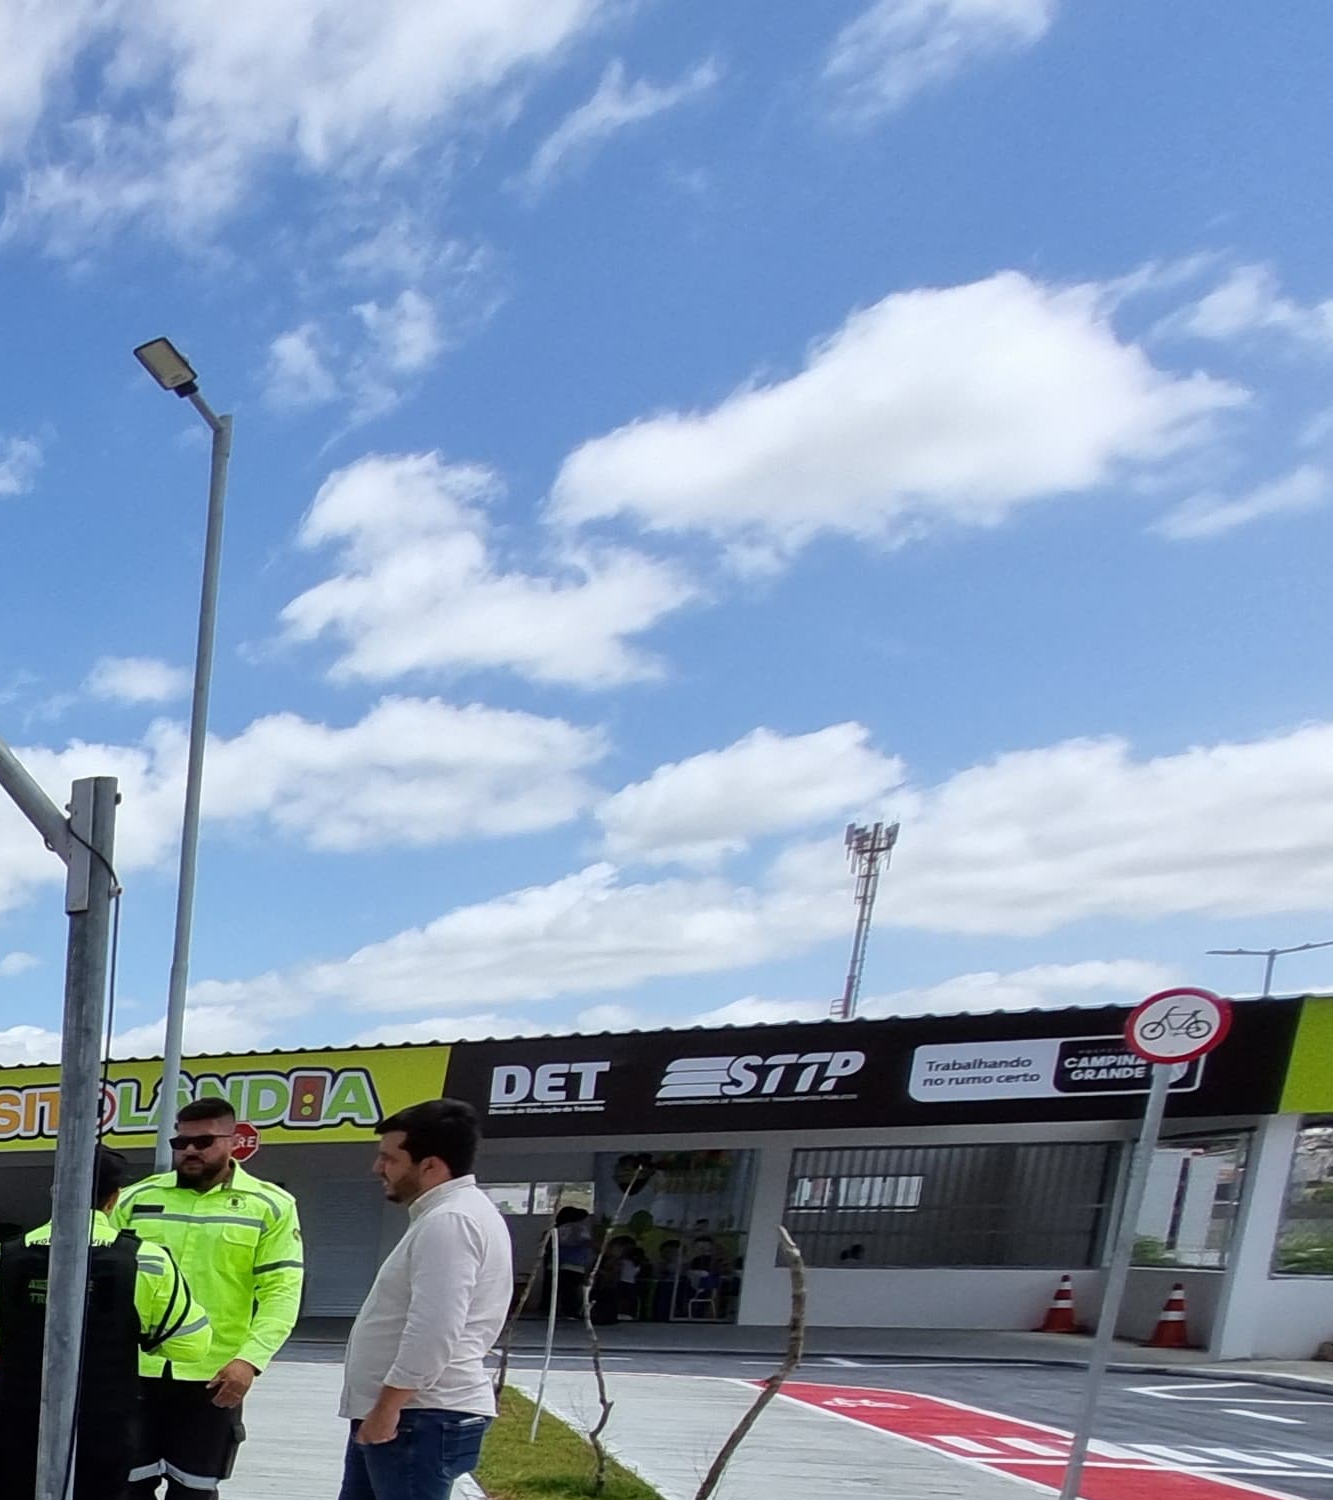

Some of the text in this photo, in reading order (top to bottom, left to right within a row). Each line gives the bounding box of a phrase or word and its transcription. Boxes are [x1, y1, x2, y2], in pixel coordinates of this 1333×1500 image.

[926, 1056, 1033, 1072] Trabalhando
[1063, 1054, 1147, 1069] CAMPINA
[721, 1050, 866, 1096] STTP
[922, 1072, 1041, 1087] no rumo certo
[1070, 1066, 1147, 1081] GRANDE
[489, 1061, 611, 1103] DET
